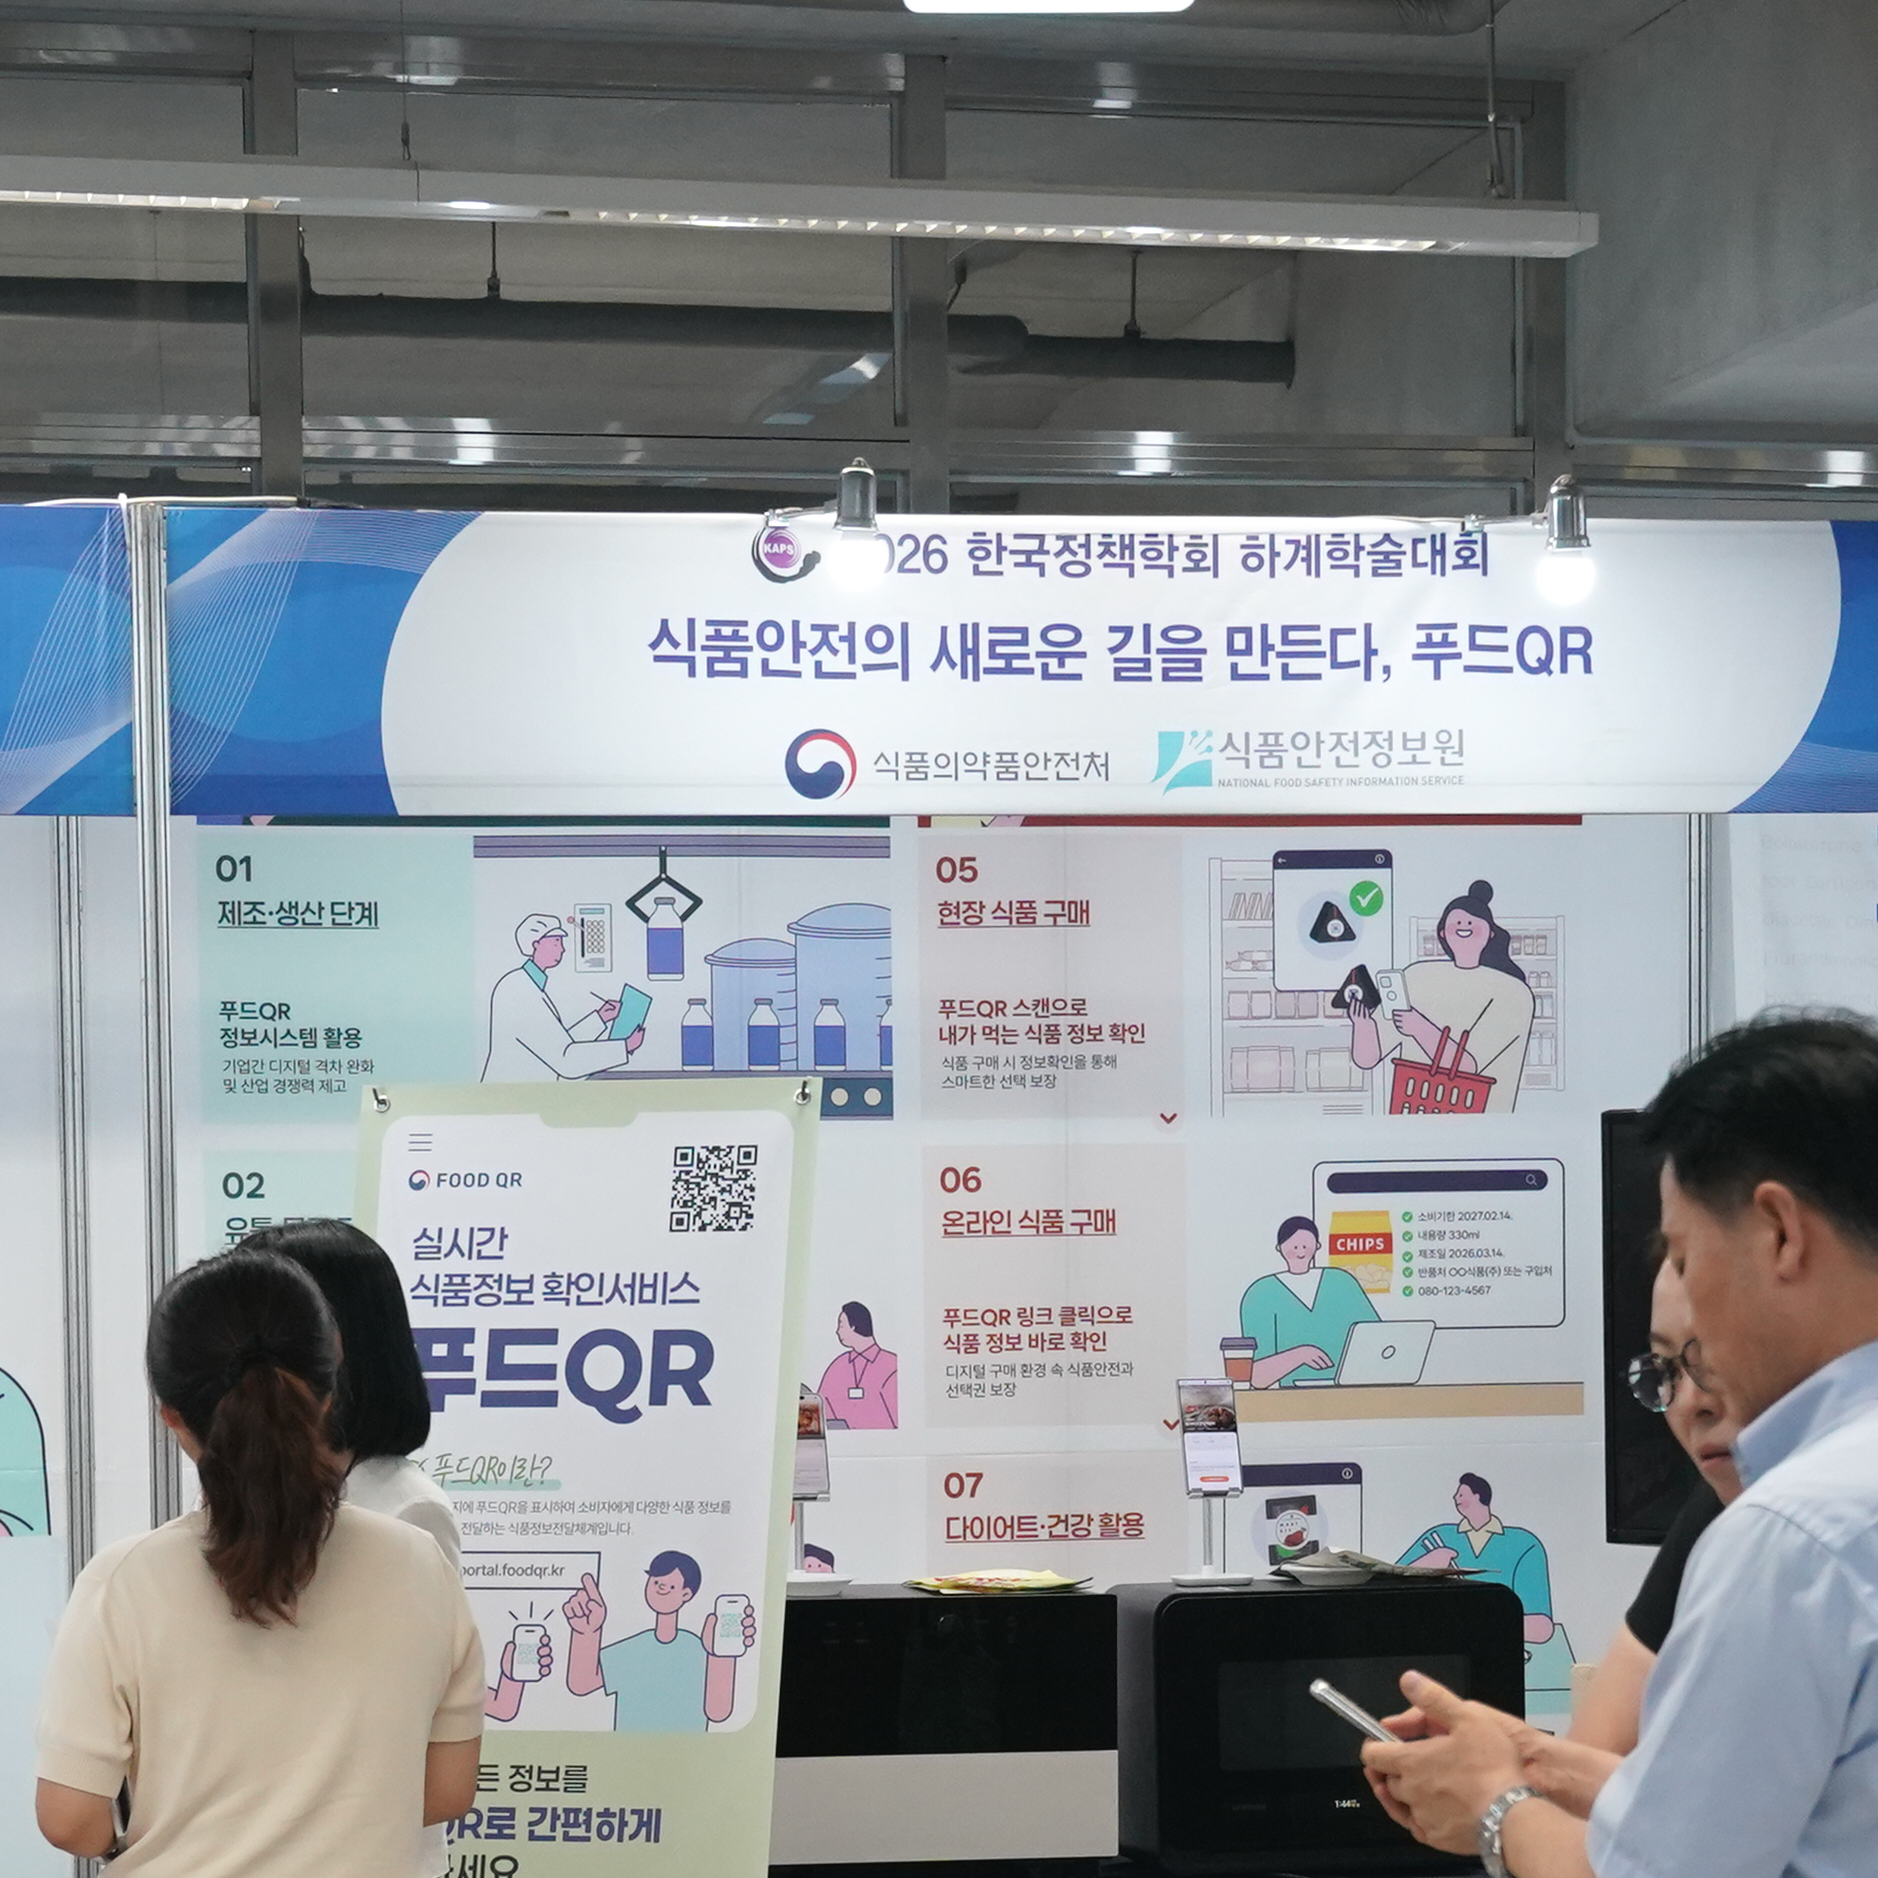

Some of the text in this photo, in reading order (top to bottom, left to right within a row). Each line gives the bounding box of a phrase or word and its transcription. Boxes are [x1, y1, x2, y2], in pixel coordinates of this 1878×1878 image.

[762, 540, 795, 558] KAPS
[967, 532, 1489, 578] 한국정책학회 하계학술대회
[648, 617, 1592, 682] 식품안전의 새로운 길을 만든다, 푸드QR
[874, 729, 1463, 781] 식품의약품안전처 식품안전정보원
[216, 855, 251, 882] 01
[937, 857, 978, 883] 05
[218, 901, 379, 927] 제조·생산 단계
[938, 900, 1090, 926] 현장 식품 구매
[219, 1001, 290, 1021] 푸드QR
[939, 998, 1088, 1019] 푸드QR 스캔으로
[221, 1027, 362, 1048] 정보시스템 활용
[940, 1023, 1145, 1045] 내가 먹는 식품 정보 확인
[223, 1059, 374, 1074] 기업간 디지털 격차 완화
[942, 1054, 1118, 1071] 식품 구매 시 정보확인을 통해
[224, 1079, 346, 1094] 및 산업 경쟁력 제고
[942, 1074, 1056, 1089] 스마트한 선택 보장
[223, 1172, 264, 1198] 02
[437, 1173, 522, 1188] FOOD QR
[940, 1167, 981, 1193] 06
[942, 1208, 1117, 1235] 온라인 식품 구매
[414, 1227, 508, 1260] 실시간
[1337, 1238, 1384, 1250] CHIPS
[410, 1272, 700, 1307] 식품정보 확인서비스
[943, 1306, 1133, 1328] 푸드QR 링크 클릭으로
[944, 1331, 1106, 1354] 식품 정보 바로 확인
[412, 1327, 715, 1425] 푸드QR
[432, 1453, 552, 1488] 푸드QR이란?
[944, 1473, 983, 1498] 07
[477, 1501, 730, 1514] 푸드QR을 표시하여 소비자에게 다양한 식품 정보를
[945, 1512, 1144, 1540] 다이어트·건강 활용
[509, 1765, 588, 1793] 정보를
[528, 1807, 661, 1843] 간편하게
